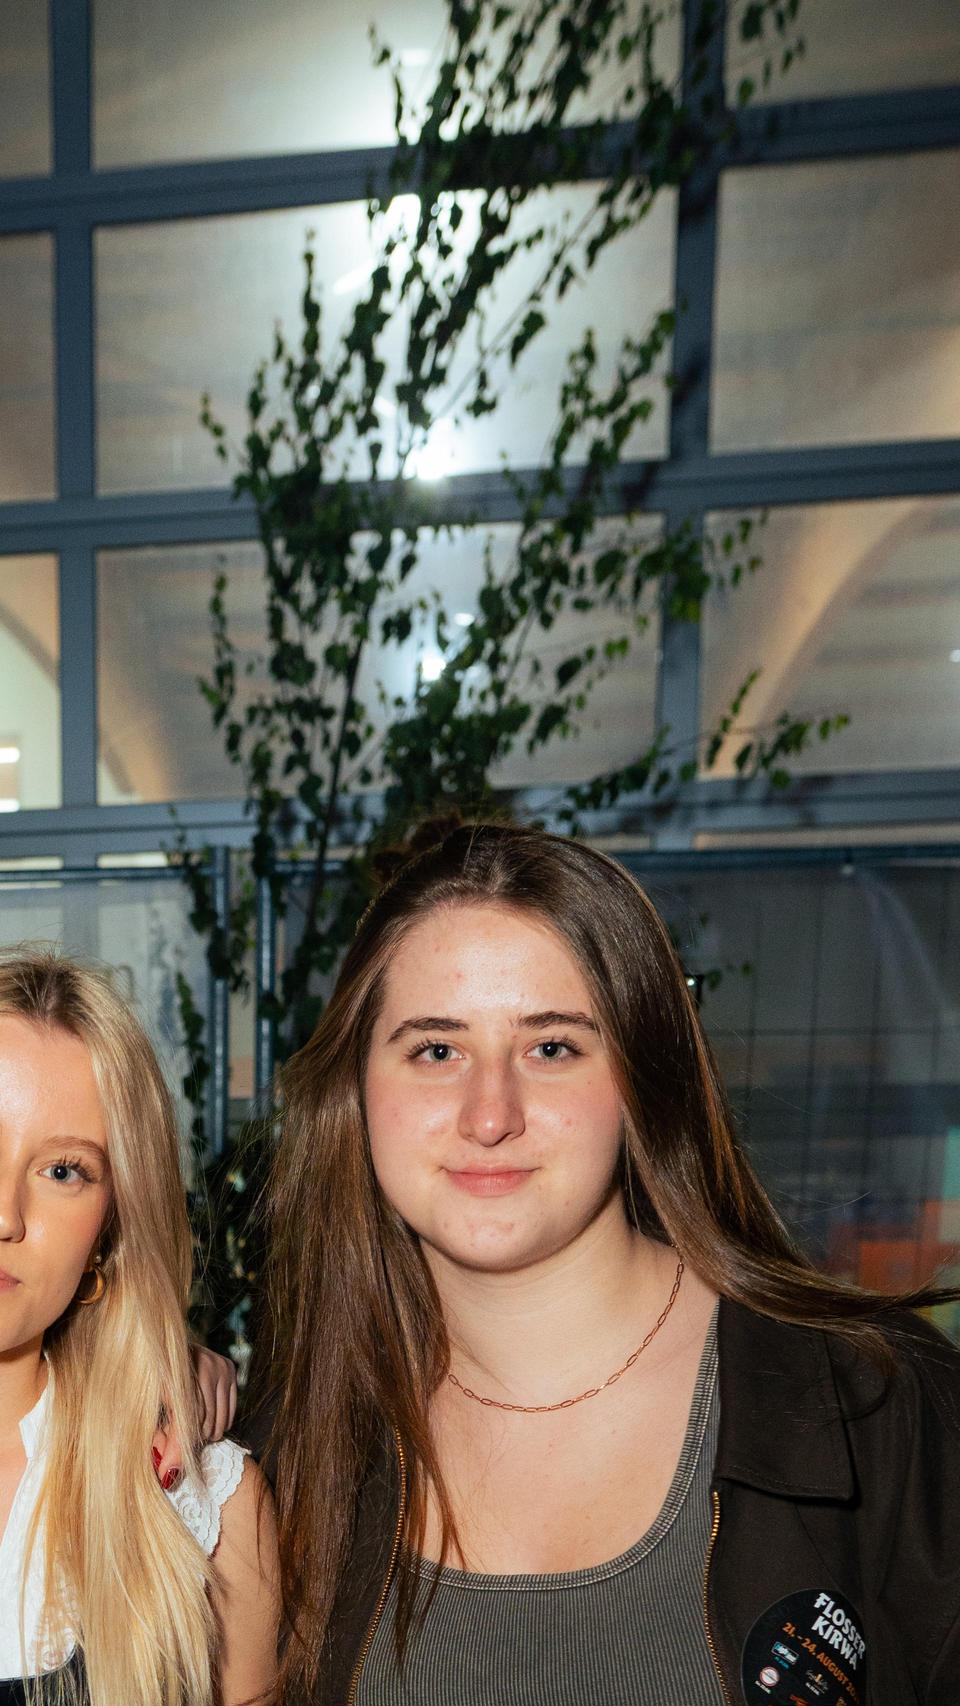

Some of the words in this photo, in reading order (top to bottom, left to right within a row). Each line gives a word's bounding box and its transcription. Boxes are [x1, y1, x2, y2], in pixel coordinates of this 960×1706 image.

[811, 1616, 858, 1670] KIRWA
[814, 1592, 866, 1660] FLOSSER
[816, 1652, 850, 1686] AUGUST
